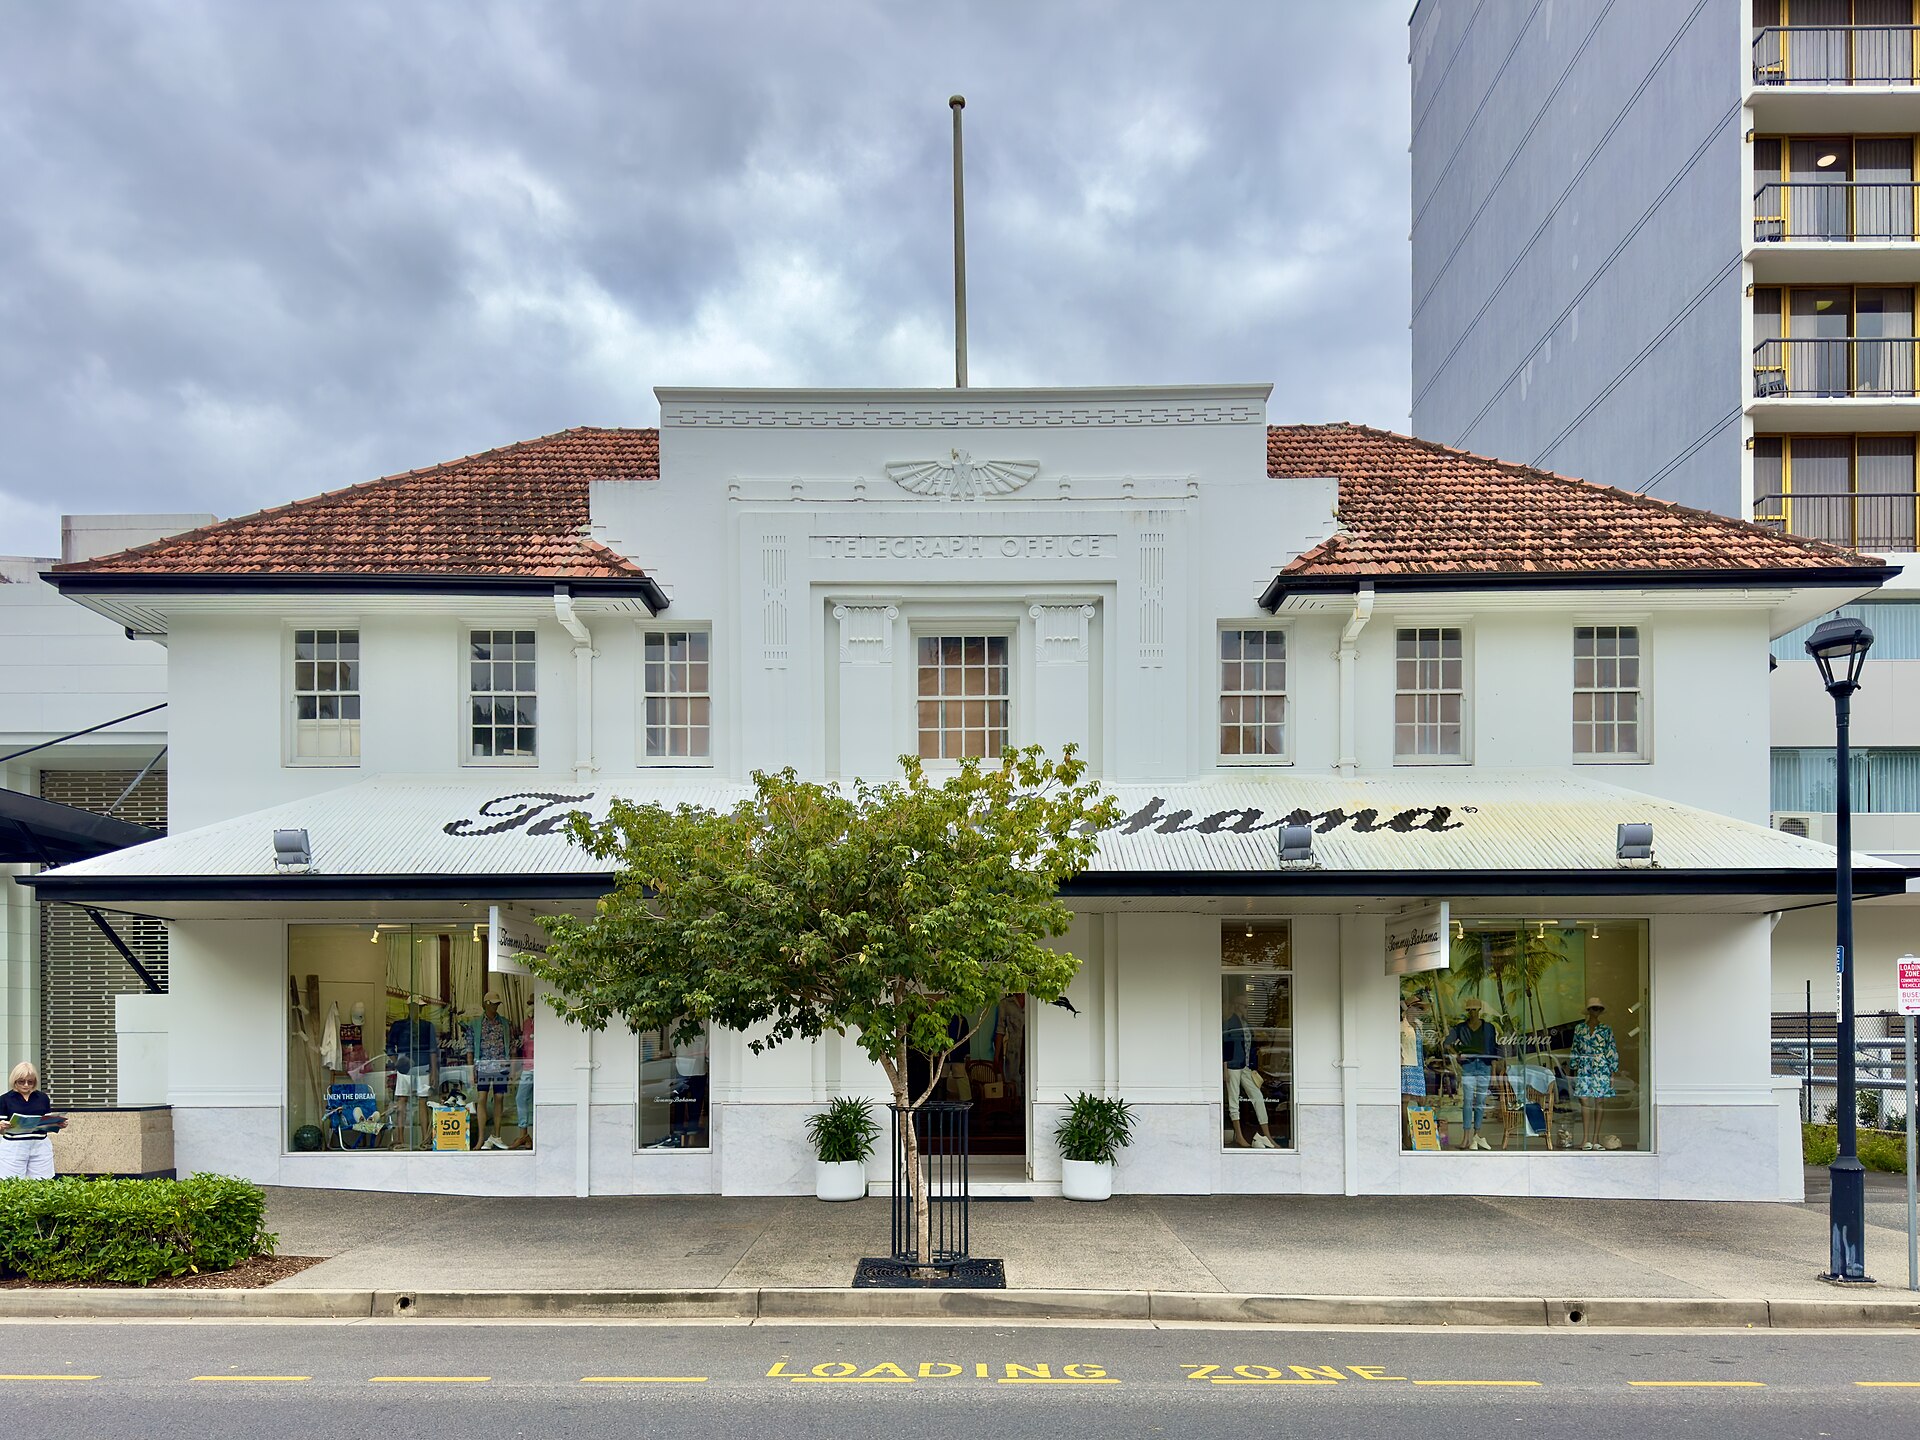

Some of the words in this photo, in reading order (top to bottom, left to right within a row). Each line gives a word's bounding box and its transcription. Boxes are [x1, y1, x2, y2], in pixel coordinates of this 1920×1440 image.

[1001, 536, 1099, 557] OFFICE
[1410, 928, 1439, 947] Bahama
[766, 1362, 1108, 1378] LOADING
[1180, 1364, 1408, 1380] ZONE
